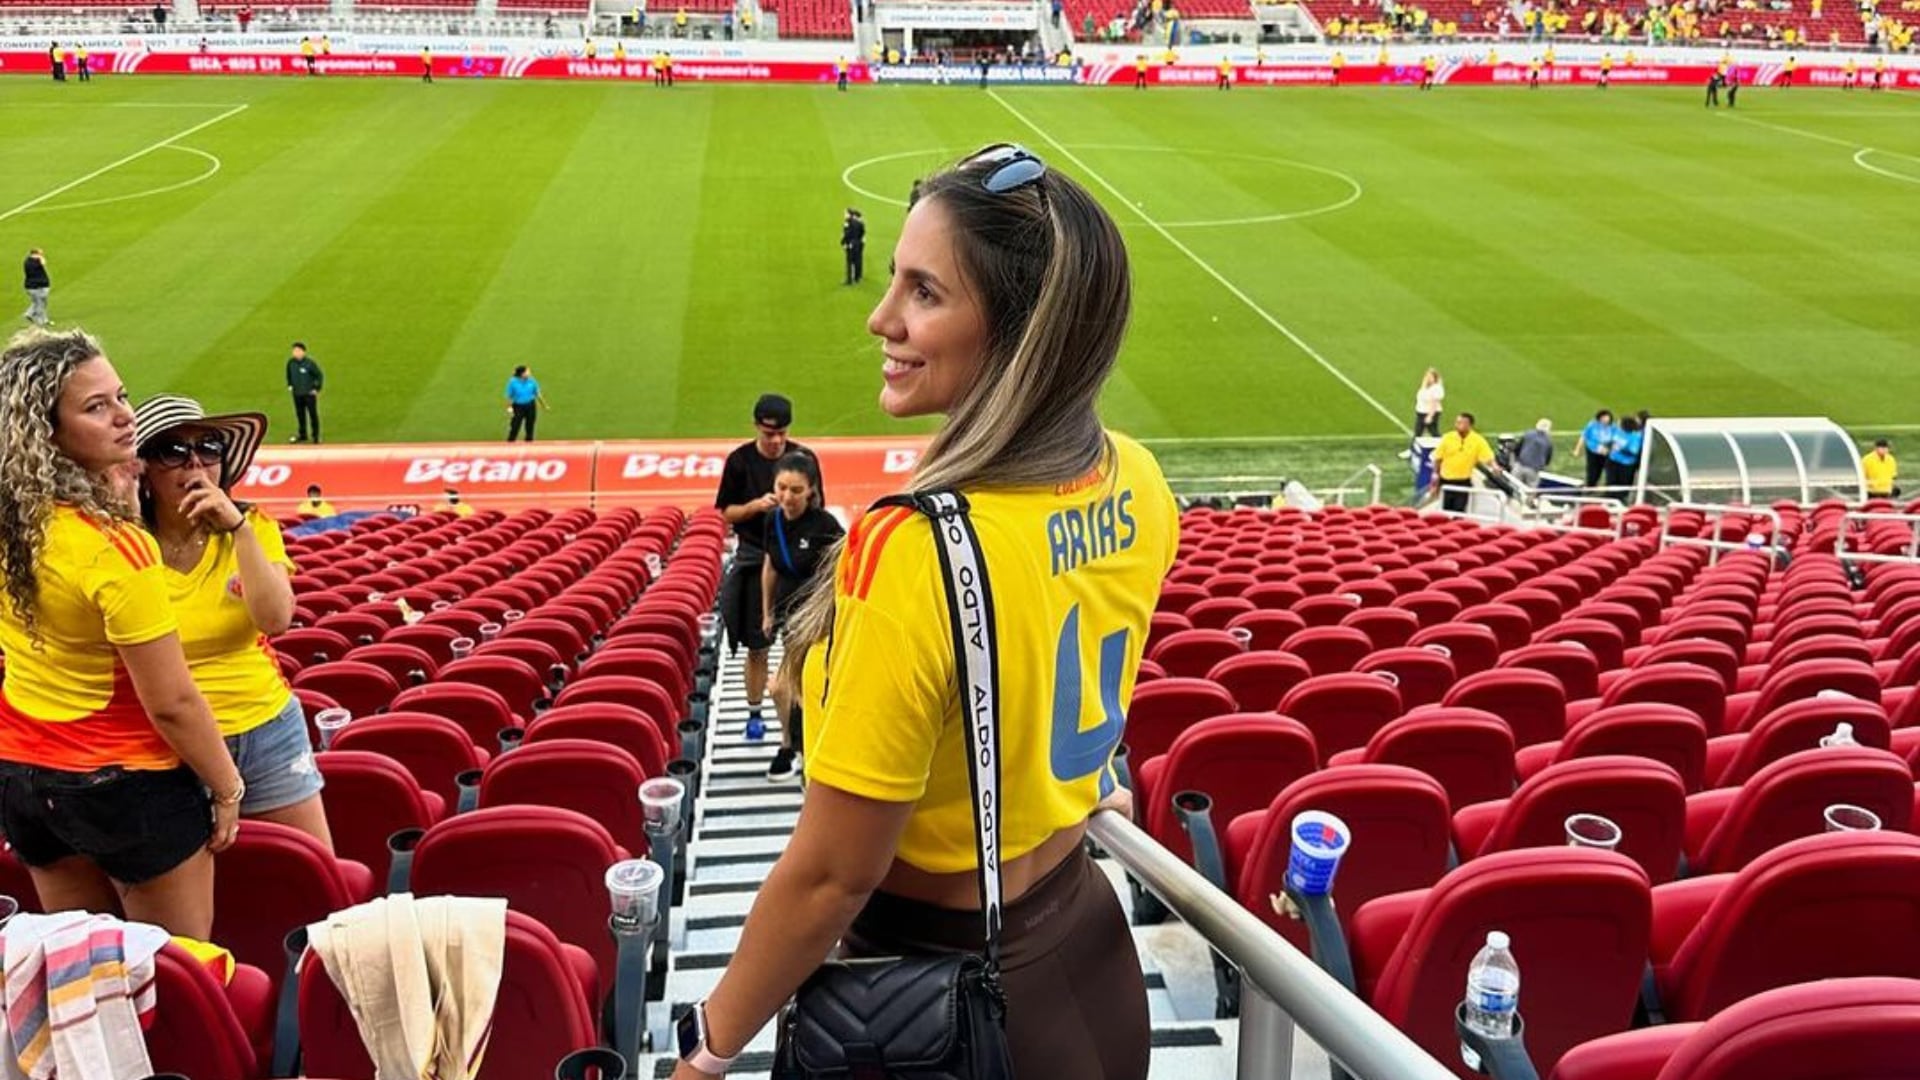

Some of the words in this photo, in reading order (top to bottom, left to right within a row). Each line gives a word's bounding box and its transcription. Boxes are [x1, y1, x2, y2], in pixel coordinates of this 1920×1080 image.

[266, 38, 306, 46] AMERIC
[567, 62, 622, 77] FOLLOW
[880, 66, 941, 79] CONMEBO
[971, 67, 1020, 80] AERICA
[404, 458, 566, 484] Betano
[622, 453, 727, 479] Beta
[1047, 488, 1136, 577] ARIAS
[959, 566, 985, 650] ALDO
[973, 684, 990, 768] ALDO
[1050, 602, 1128, 799] 4
[982, 790, 996, 872] ALDO
